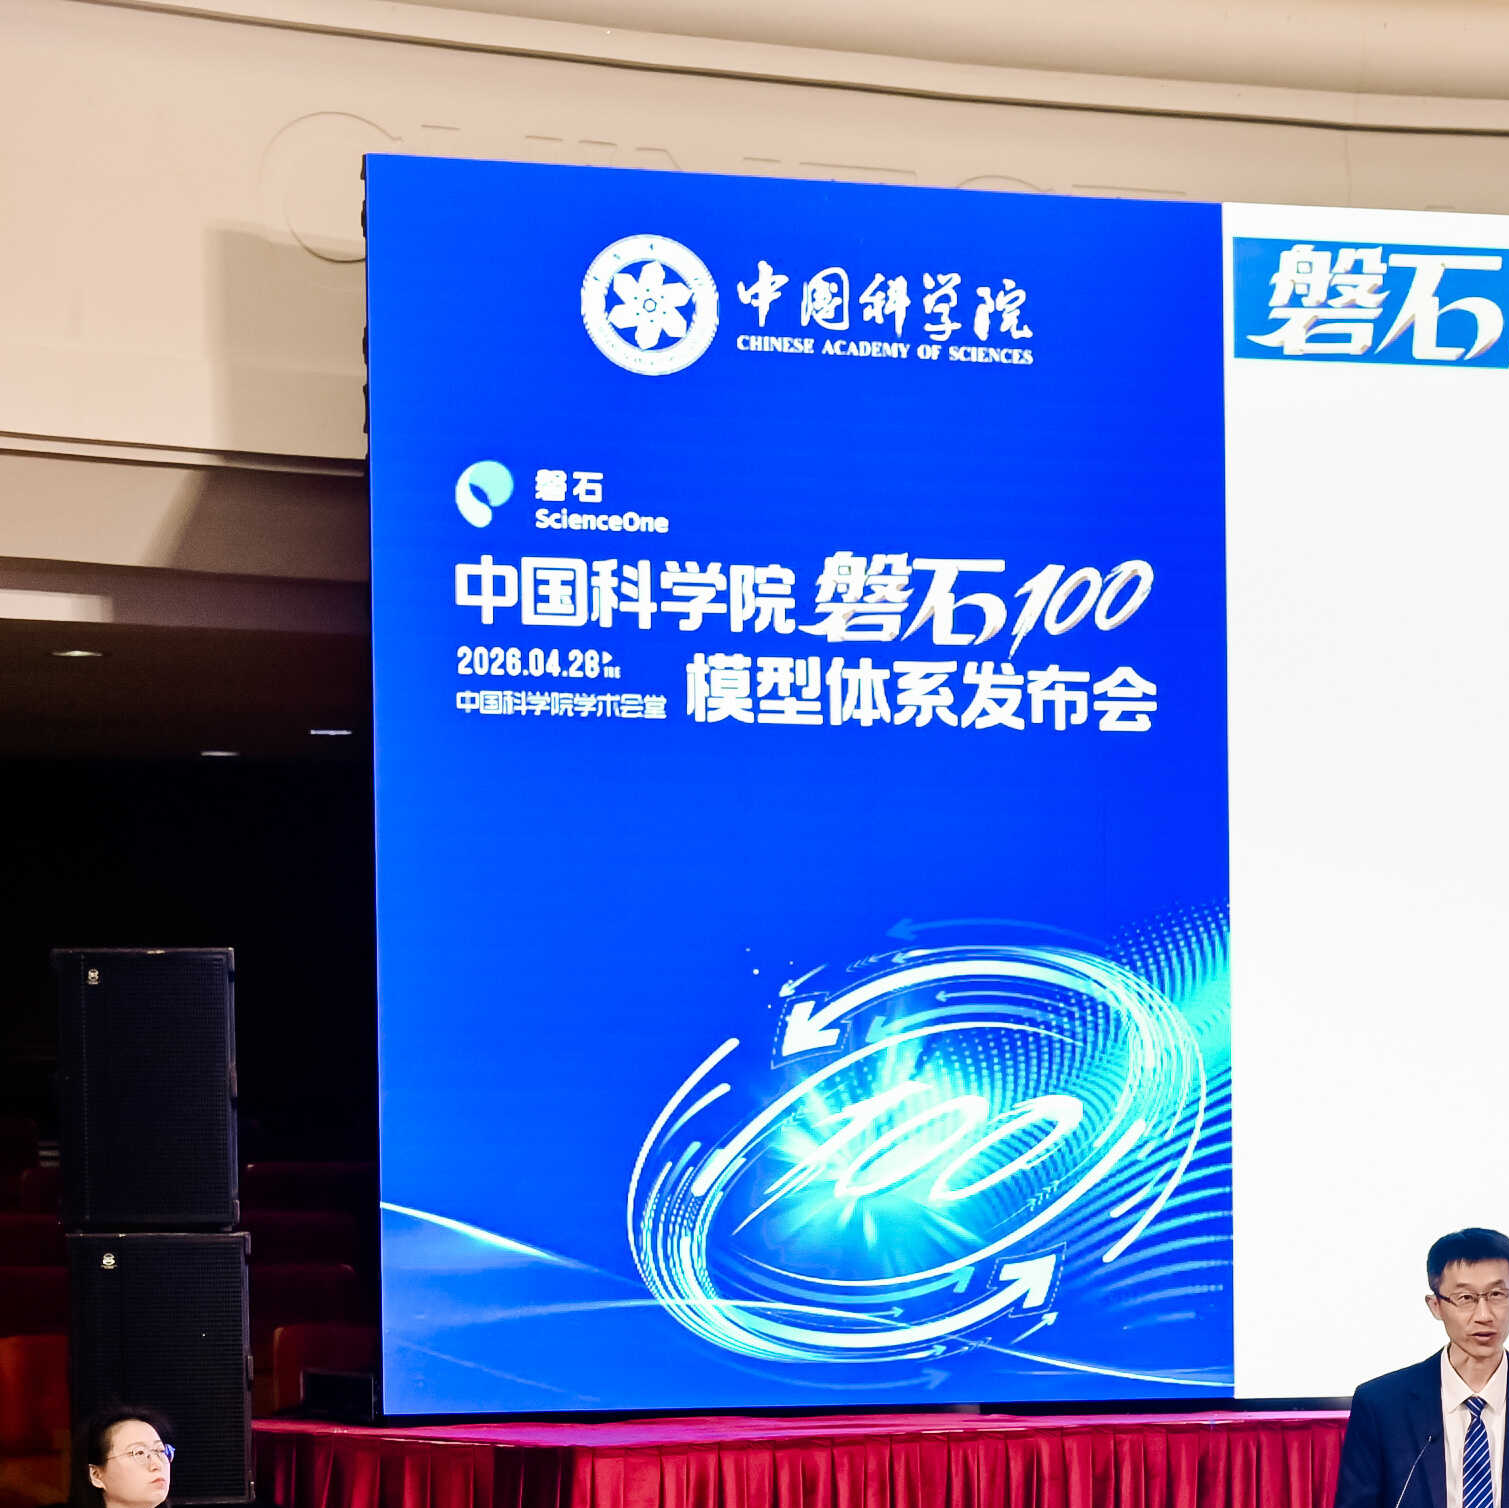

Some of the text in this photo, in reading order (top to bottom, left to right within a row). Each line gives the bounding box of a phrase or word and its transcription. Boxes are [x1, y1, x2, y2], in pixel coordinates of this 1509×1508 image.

[737, 335, 1034, 366] CHINESE ACADEMY OF SCIENCES
[535, 508, 669, 534] ScienceOne
[457, 646, 600, 679] 2026.04.28
[456, 690, 667, 720] 中国科学院学术会堂
[686, 653, 1158, 733] 模型体系发布会
